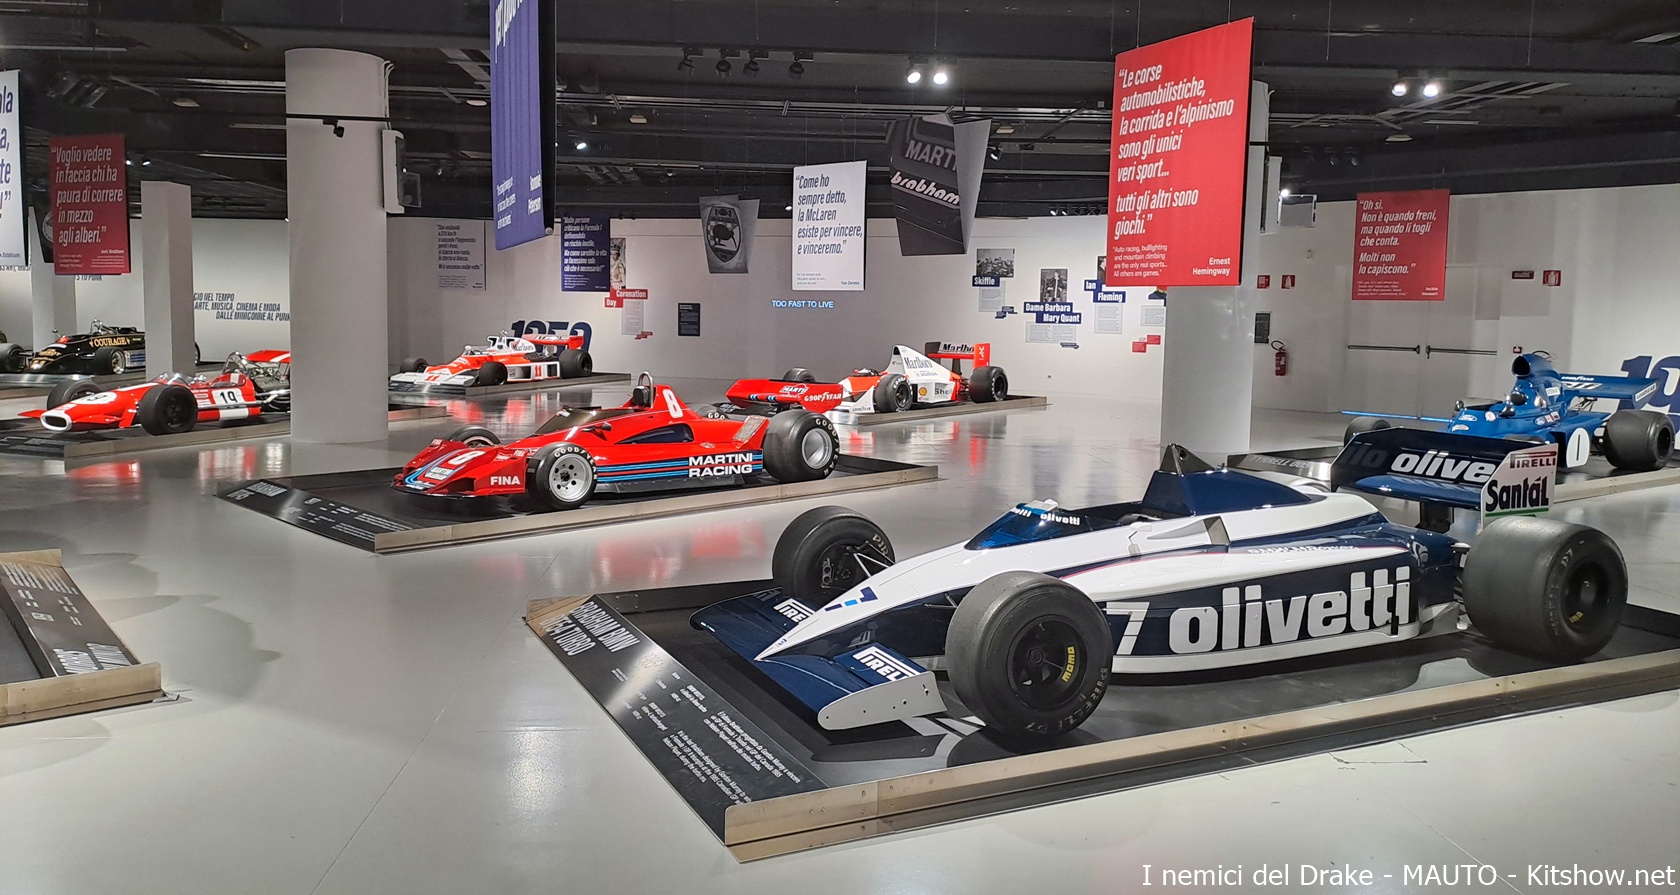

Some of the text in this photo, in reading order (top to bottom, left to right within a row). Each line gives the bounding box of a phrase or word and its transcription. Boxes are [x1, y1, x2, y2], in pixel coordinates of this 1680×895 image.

[1135, 64, 1162, 85] corse
[1120, 76, 1206, 112] automobilistiche,
[1120, 116, 1128, 136] la
[1130, 109, 1164, 133] corrida
[1166, 113, 1172, 127] e
[1118, 130, 1183, 159] sono gli unici
[83, 145, 112, 161] vedere
[56, 165, 117, 183] in faccia chi ha
[1117, 162, 1136, 182] veri
[820, 174, 829, 187] ho
[890, 171, 960, 204] brabham
[57, 186, 123, 207] paura di correre
[798, 190, 846, 207] sempre detto,
[1116, 188, 1199, 214] tutti gli altri sono
[58, 207, 93, 223] in mezzo
[798, 208, 836, 221] la McLaren
[1361, 212, 1377, 222] Non
[1384, 211, 1414, 223] quando
[1415, 210, 1436, 221] freni,
[798, 224, 863, 240] esiste per vincere,
[1361, 222, 1432, 236] ma quando li togli
[59, 226, 73, 247] agli
[1360, 236, 1399, 246] che conta.
[1209, 258, 1230, 266] Ernest
[1359, 252, 1395, 262] Molti non
[1193, 268, 1230, 276] Hemingway
[1359, 264, 1366, 274] lo
[974, 277, 995, 286] Skiffle
[772, 300, 787, 308] TOO
[788, 300, 806, 308] FAST
[1098, 293, 1122, 302] Fleming
[1026, 303, 1044, 312] Dame
[1043, 314, 1079, 323] Mary Quant
[94, 338, 126, 346] COURAGE
[904, 356, 933, 369] Marlboro
[535, 365, 541, 376] 11
[220, 391, 238, 404] 19
[662, 389, 683, 418] 8
[804, 392, 842, 402] GOODYEAR
[448, 451, 486, 465] 8
[554, 446, 598, 480] GOODYEAR
[689, 453, 753, 466] MARTINI
[1510, 451, 1556, 468] PIRELLI
[689, 465, 753, 478] RACING
[490, 476, 520, 486] FINA
[1040, 513, 1080, 526] olivetti
[1169, 566, 1410, 654] olivetti
[567, 600, 641, 652] BRABHAM BMW
[1106, 601, 1150, 655] 7
[551, 626, 597, 656] TURBO
[1062, 646, 1077, 682] momo
